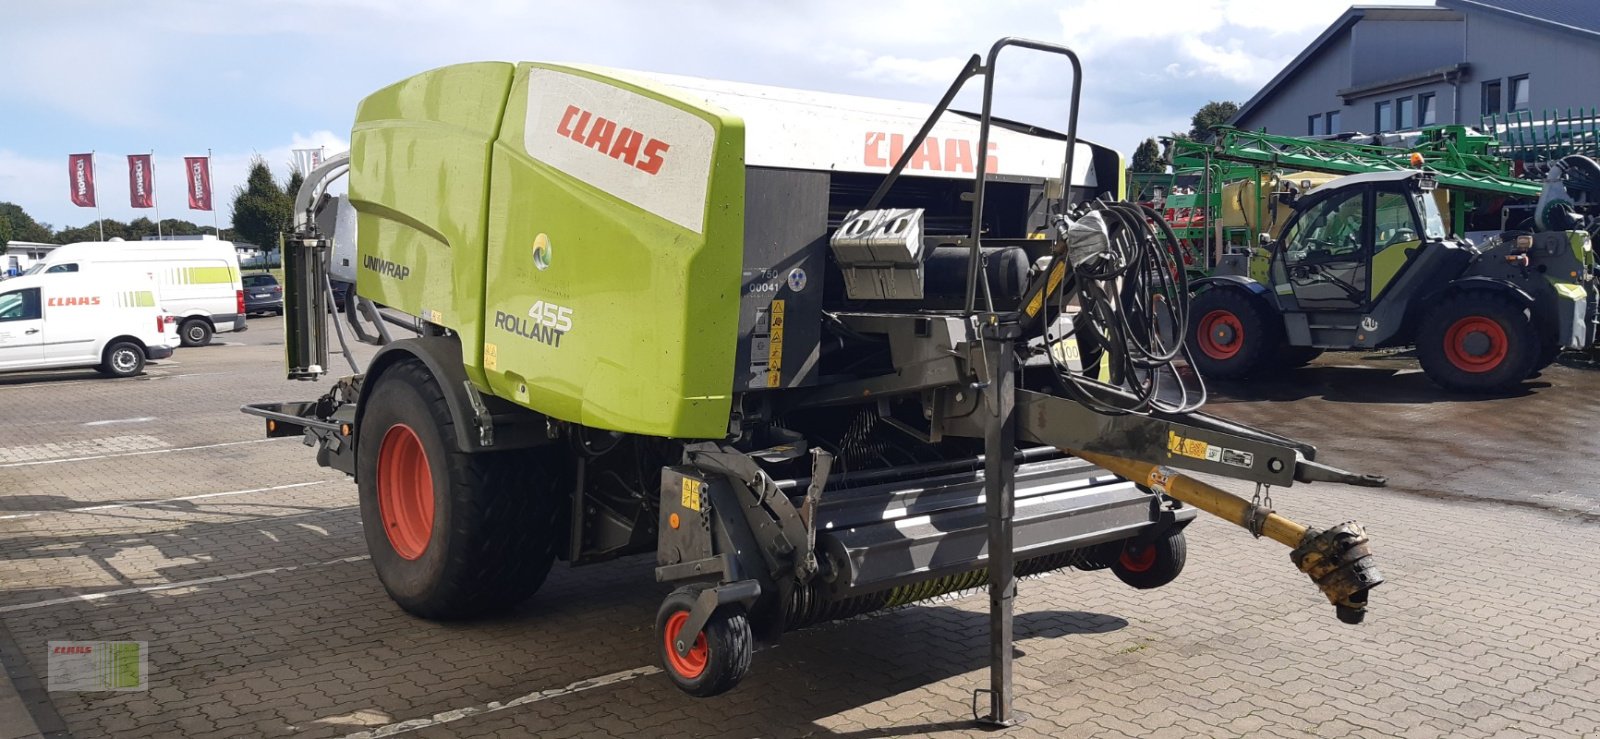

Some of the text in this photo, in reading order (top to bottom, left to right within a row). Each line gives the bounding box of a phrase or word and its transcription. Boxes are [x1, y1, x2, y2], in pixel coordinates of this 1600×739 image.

[556, 104, 670, 175] CLAAS
[863, 131, 998, 174] CLAAS
[363, 254, 410, 280] UNIWRAP
[760, 269, 778, 279] 750
[47, 296, 100, 306] CLAAS
[749, 283, 779, 292] 00041
[494, 310, 564, 348] ROLLANT
[528, 300, 573, 332] 455
